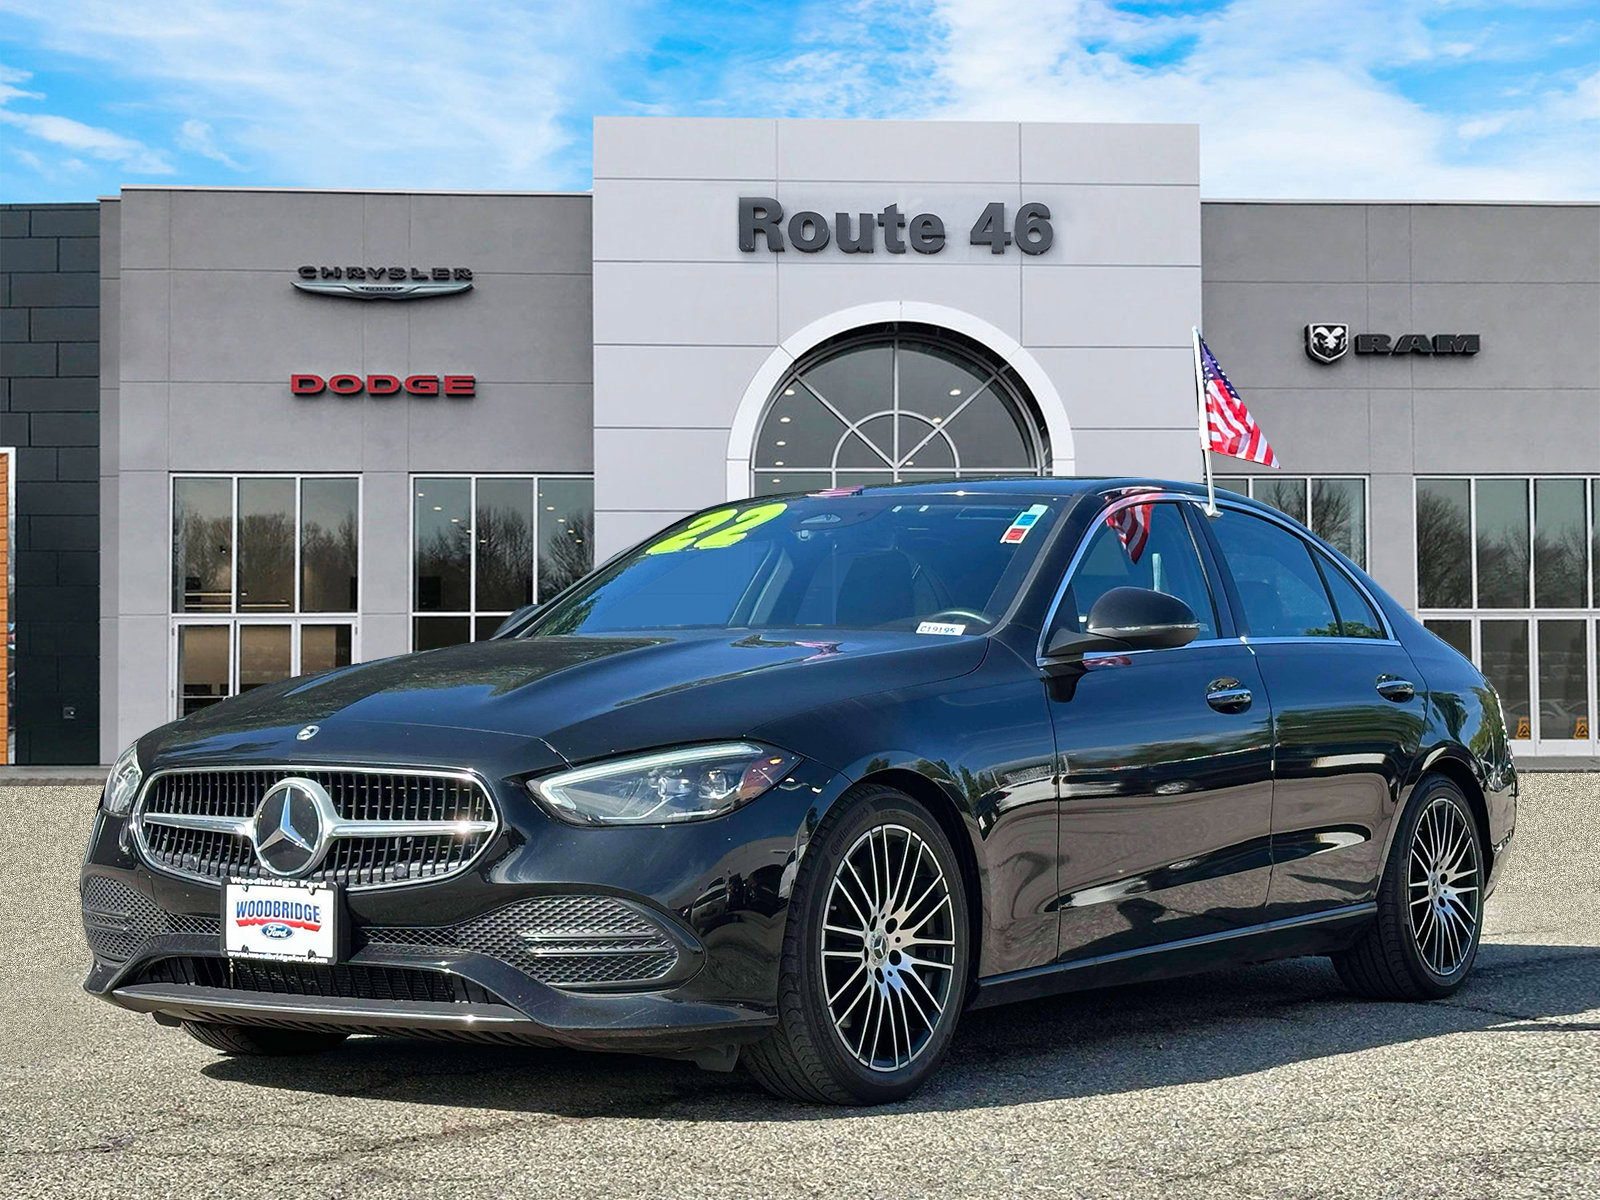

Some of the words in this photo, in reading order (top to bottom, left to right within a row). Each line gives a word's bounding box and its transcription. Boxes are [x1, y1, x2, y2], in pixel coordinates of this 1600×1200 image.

[738, 196, 946, 253] Route
[970, 202, 1053, 255] 46
[298, 266, 473, 281] CHRYSLER
[1355, 334, 1480, 355] RAM
[291, 374, 475, 396] DODGE
[646, 503, 788, 555] 22
[230, 876, 297, 888] Woodbridge
[300, 880, 327, 889] Ford
[236, 900, 321, 923] WOODBRIDGE
[265, 925, 288, 937] Ford
